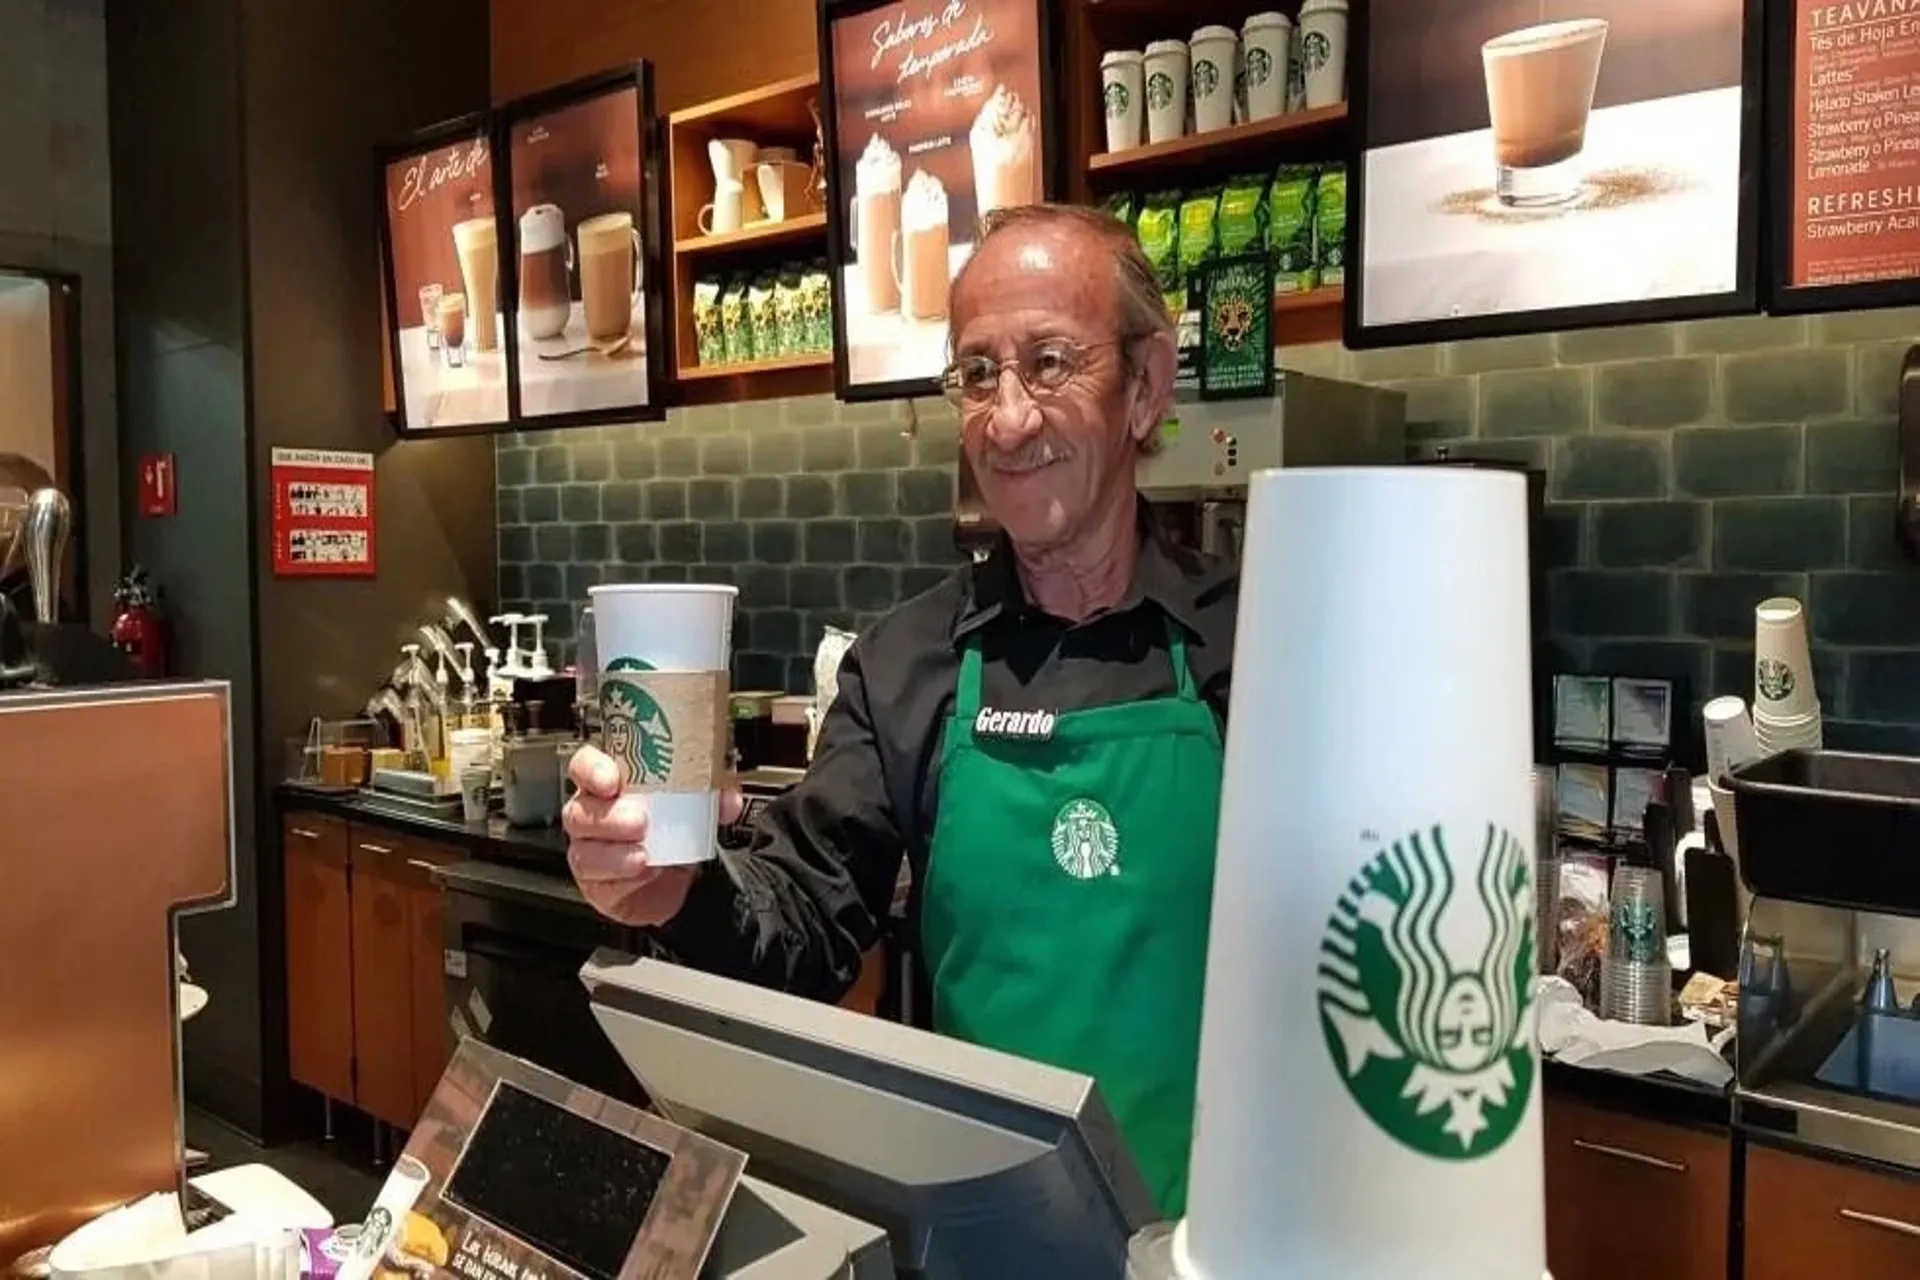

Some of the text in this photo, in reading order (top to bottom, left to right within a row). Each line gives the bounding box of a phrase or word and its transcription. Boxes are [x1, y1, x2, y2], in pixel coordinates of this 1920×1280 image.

[870, 0, 967, 70] Sabores de
[897, 12, 995, 84] temporada
[1837, 28, 1856, 47] de
[1860, 24, 1895, 50] Hoja
[1852, 87, 1900, 106] Shaken
[1808, 119, 1871, 138] Strawberry
[1808, 145, 1870, 164] Strawberry
[399, 155, 427, 210] El
[430, 148, 465, 189] arte
[1808, 160, 1870, 180] Lemonade
[1807, 185, 1920, 215] REFRESH
[1807, 221, 1882, 239] Strawberry
[976, 706, 1055, 734] Gerardo
